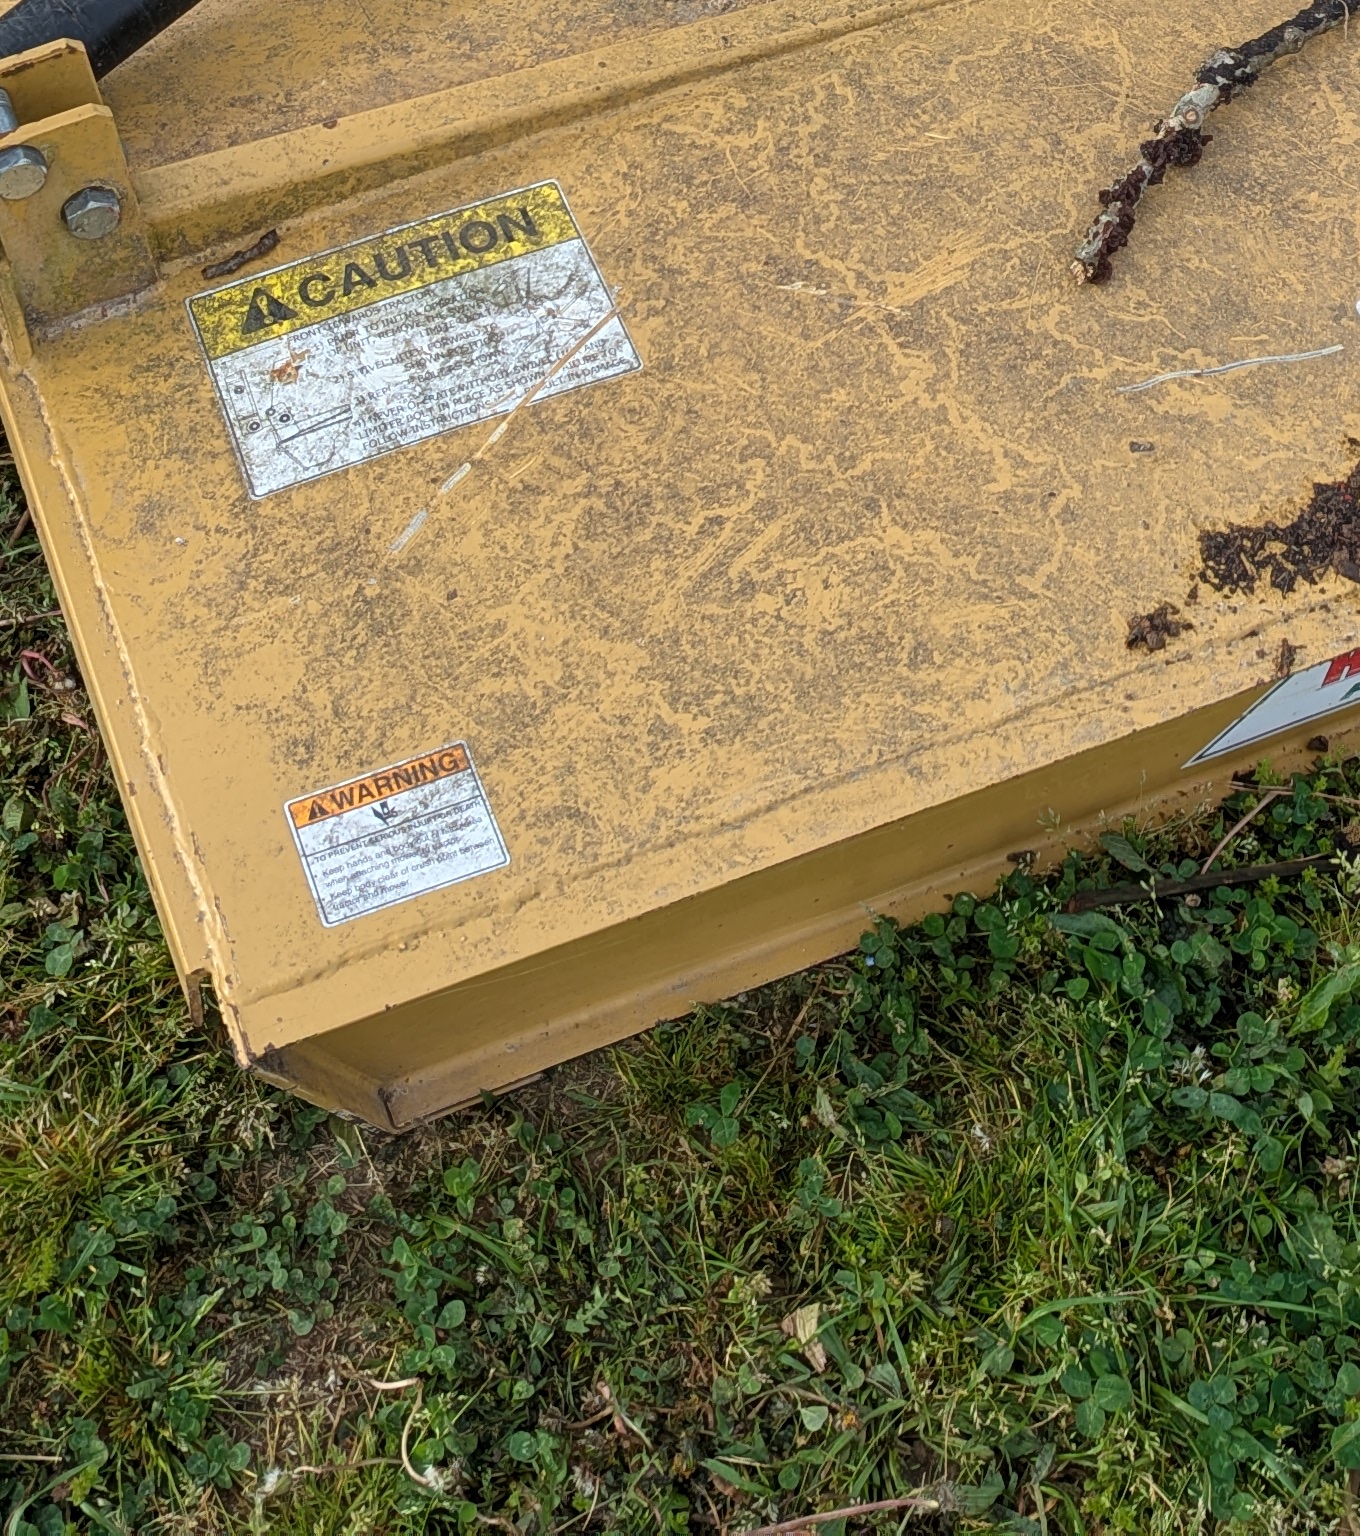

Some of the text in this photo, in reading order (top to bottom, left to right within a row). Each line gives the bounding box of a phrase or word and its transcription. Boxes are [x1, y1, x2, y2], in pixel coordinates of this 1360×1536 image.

[293, 204, 539, 311] CAUTION
[323, 307, 380, 332] TOWARDS
[377, 319, 423, 340] REMOVE
[326, 329, 360, 346] PRIOR
[364, 322, 379, 333] TO
[426, 328, 481, 353] FORWARD
[455, 369, 509, 394] WITHOUT
[361, 428, 409, 450] FOLLOW
[410, 399, 493, 434] INSTRUCTIONS
[581, 354, 627, 376] DAMAGE
[437, 401, 451, 412] IN
[452, 389, 486, 407] PLACE
[488, 384, 503, 395] AS
[329, 750, 459, 812] WARNING
[313, 853, 327, 863] TO
[327, 839, 367, 858] PREVENT
[321, 863, 345, 878] Keep
[345, 853, 373, 870] hands
[373, 846, 391, 860] and
[325, 874, 348, 888] when
[329, 886, 353, 901] Keep
[354, 878, 376, 892] body
[376, 870, 398, 884] clear
[399, 866, 410, 876] of
[458, 836, 495, 855] between
[361, 889, 379, 900] and
